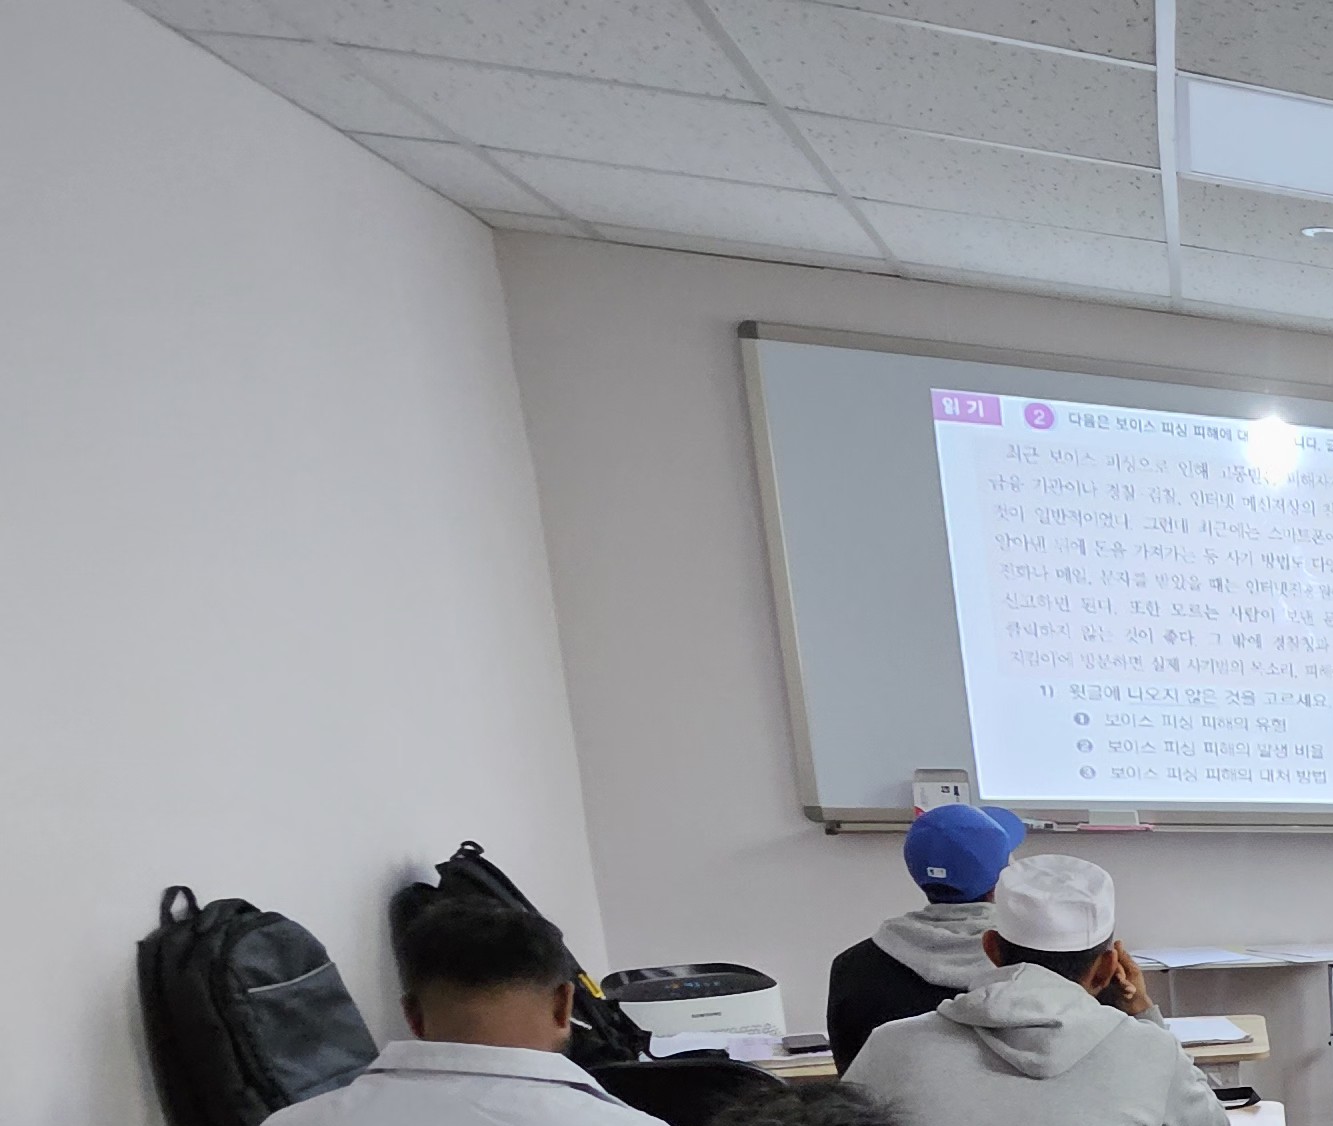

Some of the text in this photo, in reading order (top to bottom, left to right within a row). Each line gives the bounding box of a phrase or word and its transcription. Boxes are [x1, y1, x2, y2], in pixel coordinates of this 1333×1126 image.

[1068, 412, 1109, 430] 다음은
[1116, 416, 1155, 433] 보이스
[1161, 421, 1187, 437] 피싱
[1193, 424, 1232, 442] 피해에
[1006, 443, 1040, 464] 최근
[1049, 448, 1095, 466] 보이스
[1105, 452, 1167, 473] 피싱으로
[1178, 460, 1208, 480] 인해
[1032, 476, 1098, 496] 기관이나
[1189, 489, 1234, 510] 인터넷
[993, 503, 1024, 522] 것이
[1143, 515, 1188, 534] 그런데
[1199, 519, 1260, 540] 최근에는
[1134, 542, 1195, 563] 가져가는
[1227, 549, 1252, 567] 사기
[999, 562, 1048, 581] 전화나
[1154, 572, 1201, 591] 받았을
[1002, 591, 1071, 612] 신고하면
[1129, 599, 1160, 617] 또한
[1170, 602, 1219, 621] 모르는
[1231, 604, 1275, 624] 사람이
[1080, 623, 1112, 642] 않는
[1126, 626, 1153, 644] 것이
[1210, 632, 1220, 645] 그
[1231, 632, 1261, 649] 밖에
[1079, 652, 1144, 672] 방문하면
[1151, 655, 1179, 672] 실제
[1187, 657, 1244, 676] 사기범의
[1039, 683, 1332, 708] 1) 윗글에 나오지 않은 것을 고르세요.
[1104, 713, 1154, 727] 보이스
[1161, 714, 1193, 730] 피싱
[1201, 715, 1248, 731] 피해의
[1255, 717, 1286, 733] 유형
[1108, 739, 1156, 754] 보이스
[1163, 740, 1195, 756] 피싱
[1203, 741, 1250, 757] 피해의
[1257, 743, 1287, 758] 발생
[1294, 743, 1323, 759] 비율
[1110, 765, 1157, 780] 보이스
[1166, 766, 1197, 782] 피싱
[1205, 767, 1252, 782] 피해의
[1259, 768, 1290, 784] 대처
[1295, 769, 1327, 784] 방법
